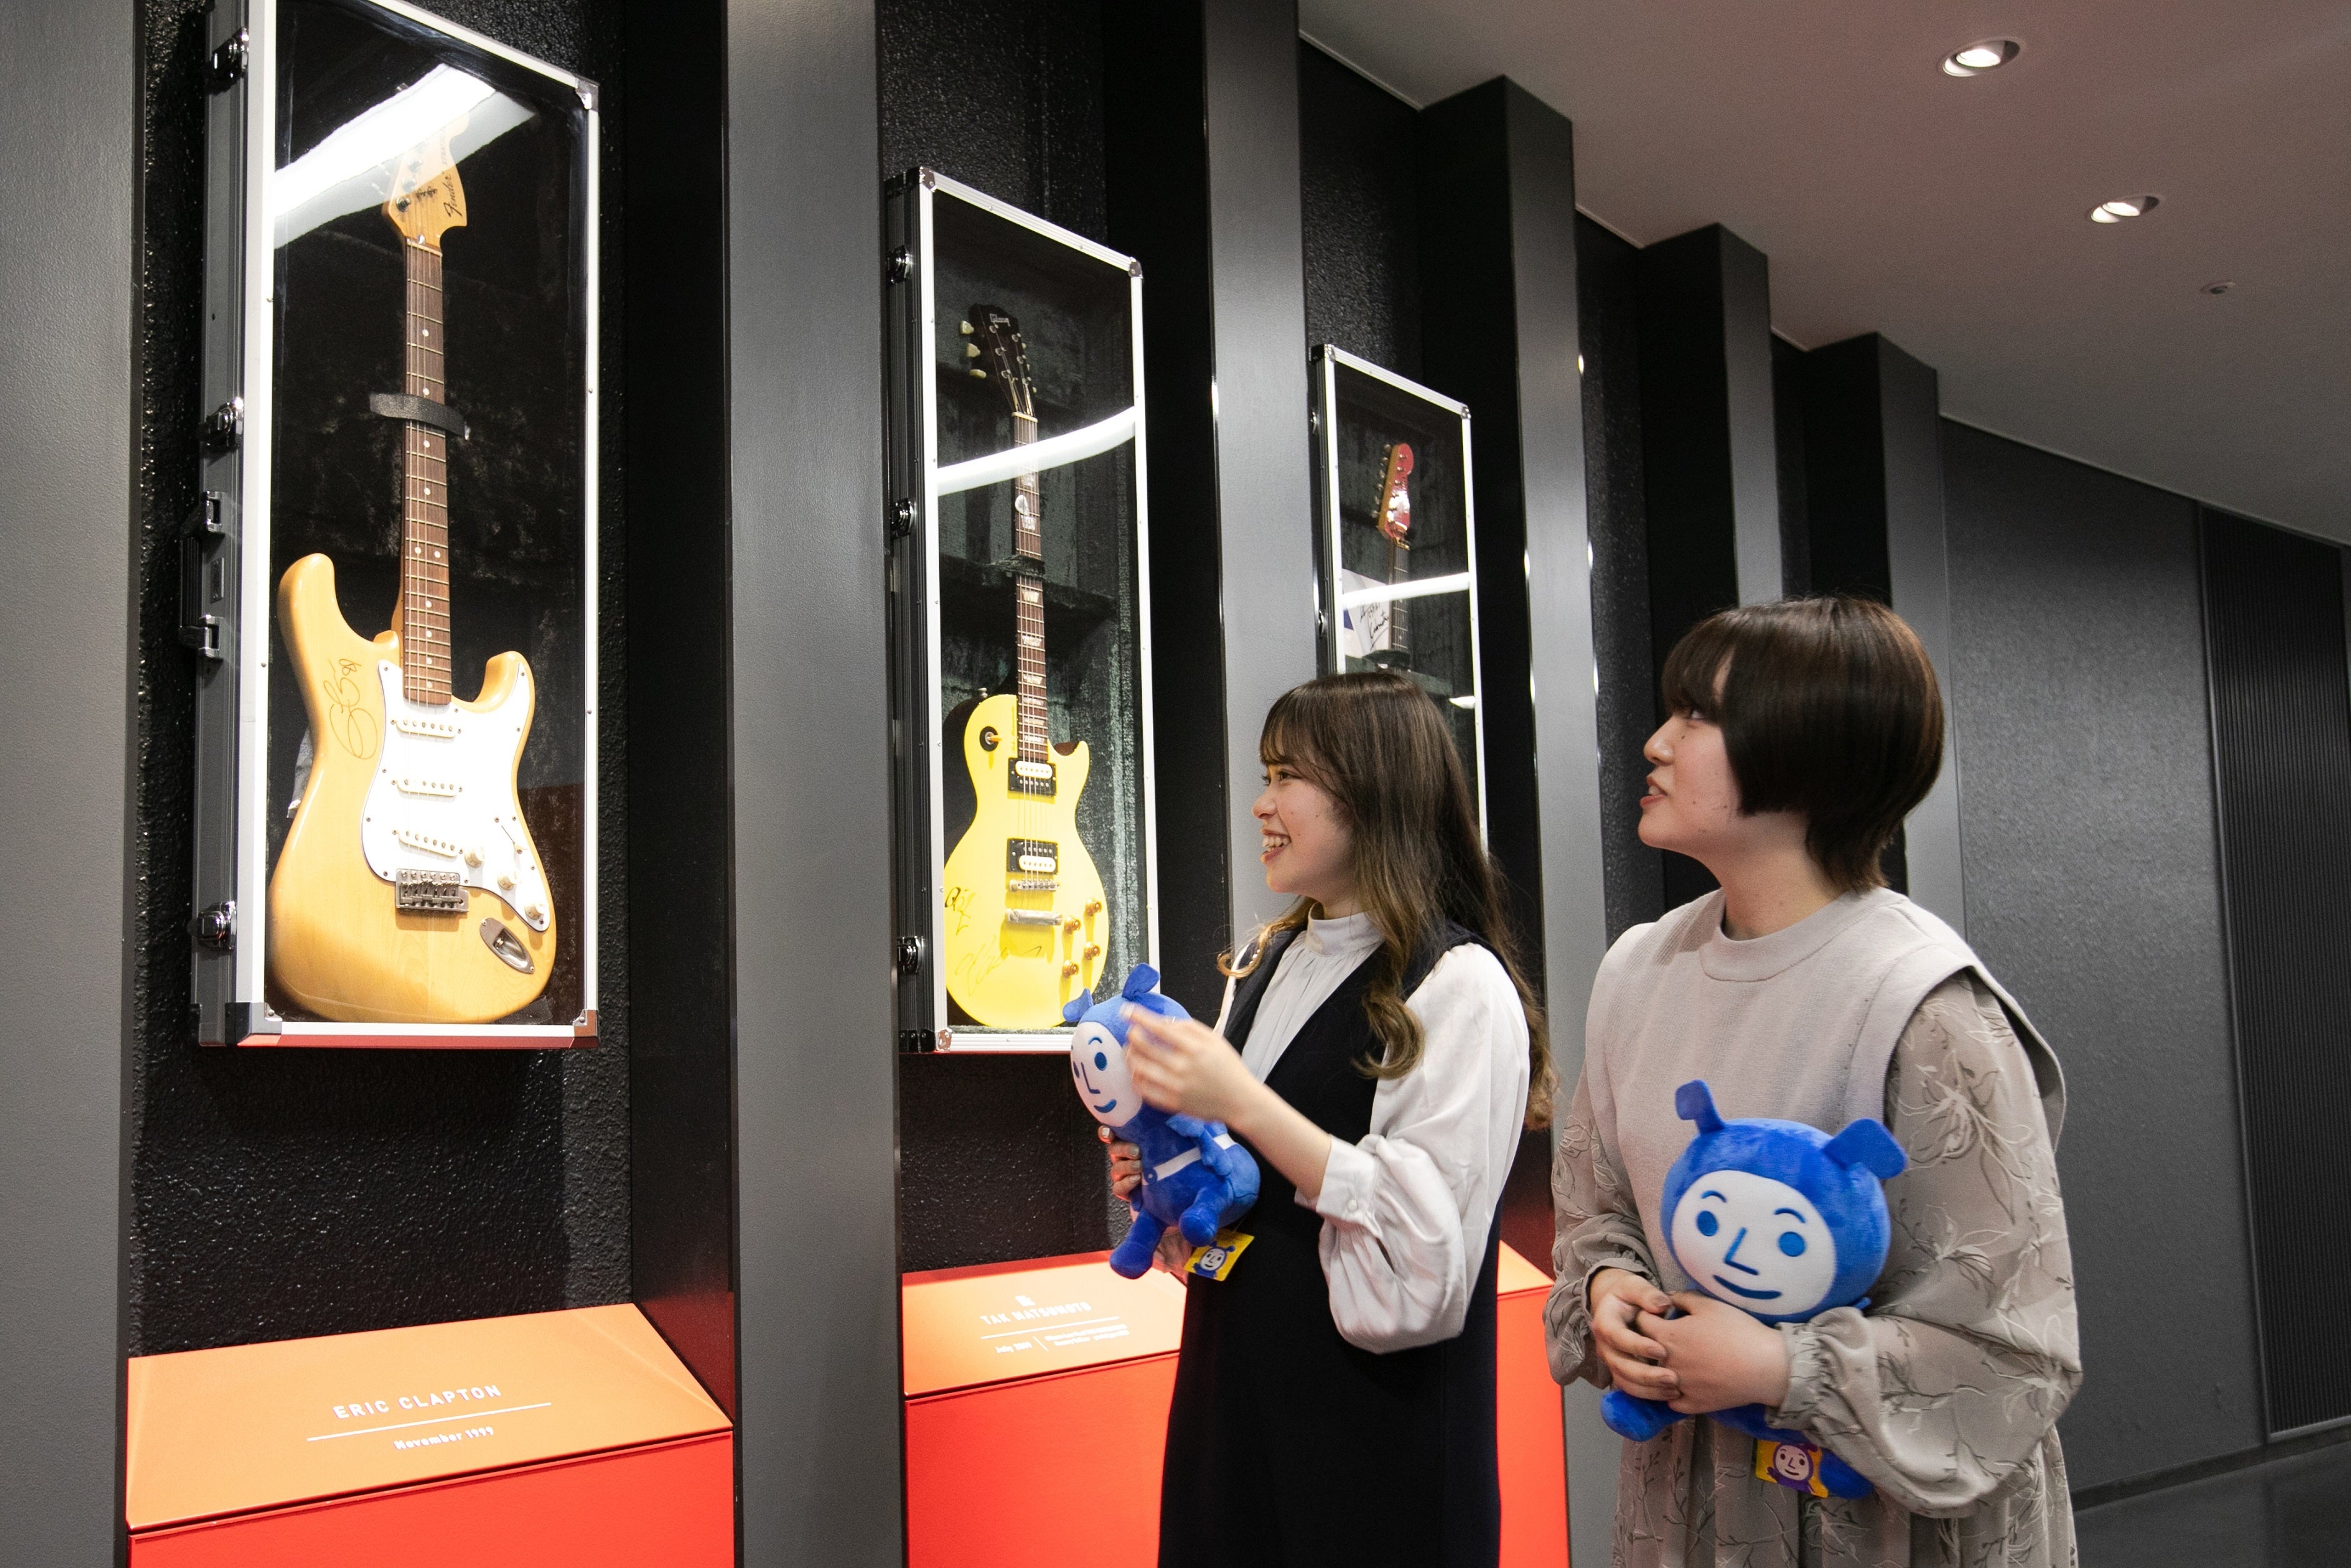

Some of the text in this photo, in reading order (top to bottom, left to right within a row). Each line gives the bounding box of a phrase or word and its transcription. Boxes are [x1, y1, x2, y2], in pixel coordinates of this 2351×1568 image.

[442, 173, 462, 218] Fender
[980, 1313, 1011, 1324] TAK
[332, 1384, 502, 1419] ERIC CLAPTON
[393, 1426, 494, 1450] November 1999
